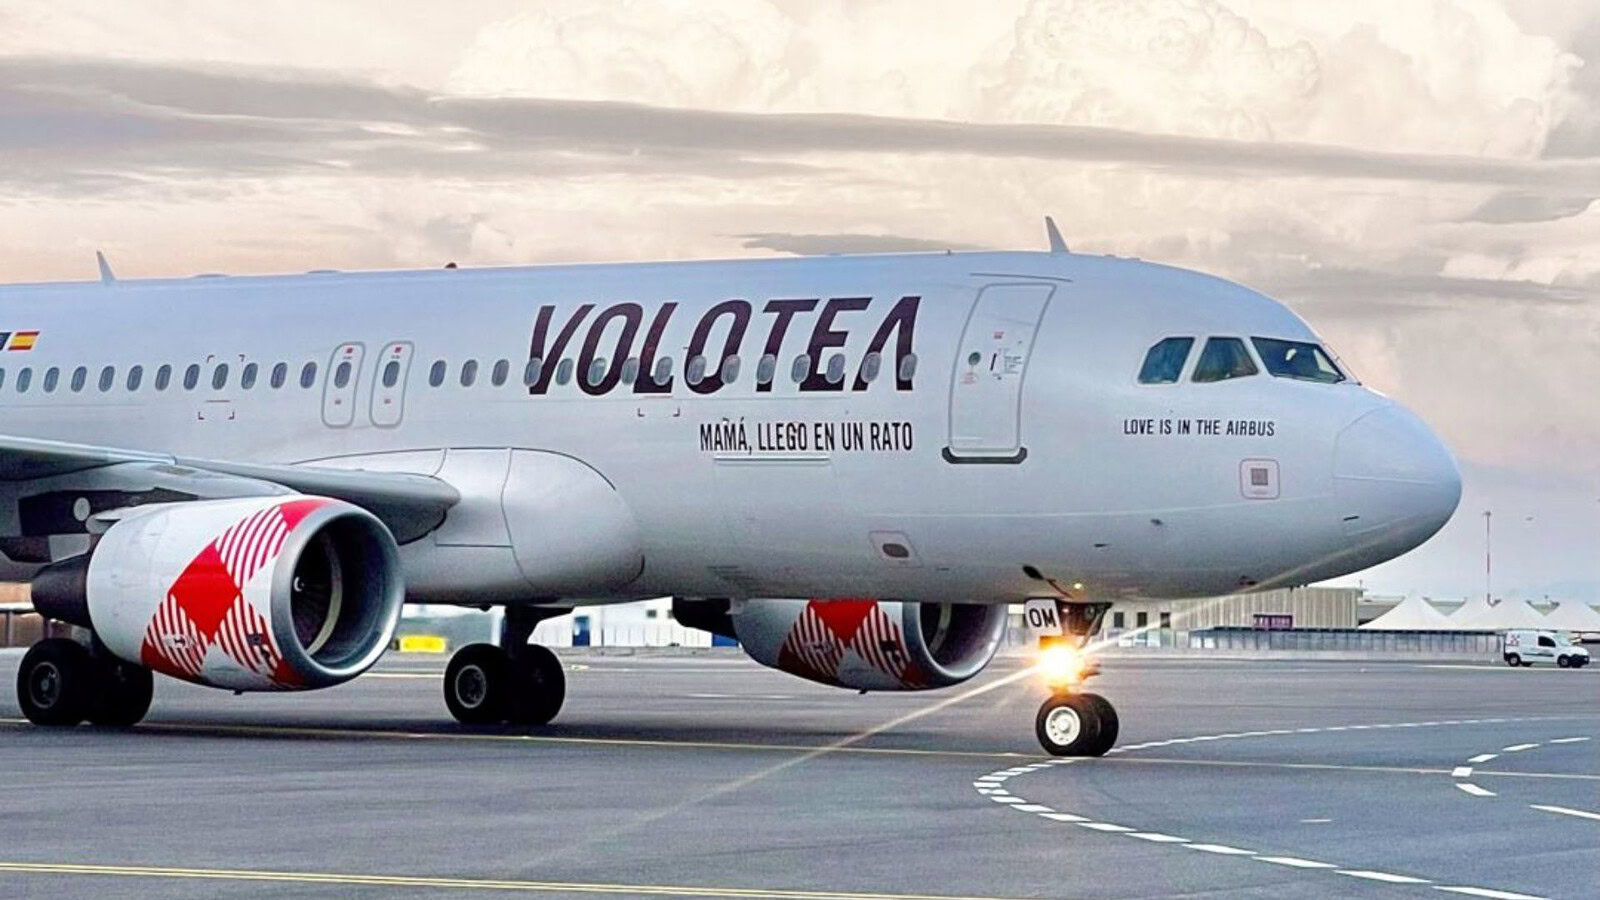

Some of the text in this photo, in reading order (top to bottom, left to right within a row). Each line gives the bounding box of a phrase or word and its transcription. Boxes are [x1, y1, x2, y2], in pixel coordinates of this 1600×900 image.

[528, 296, 921, 396] VOLOTEA
[700, 416, 913, 456] MAMÁ, LLEGO EN UN RATO
[1123, 419, 1275, 437] LOVE IS IN THE AIRBUS
[1029, 608, 1057, 628] OM
